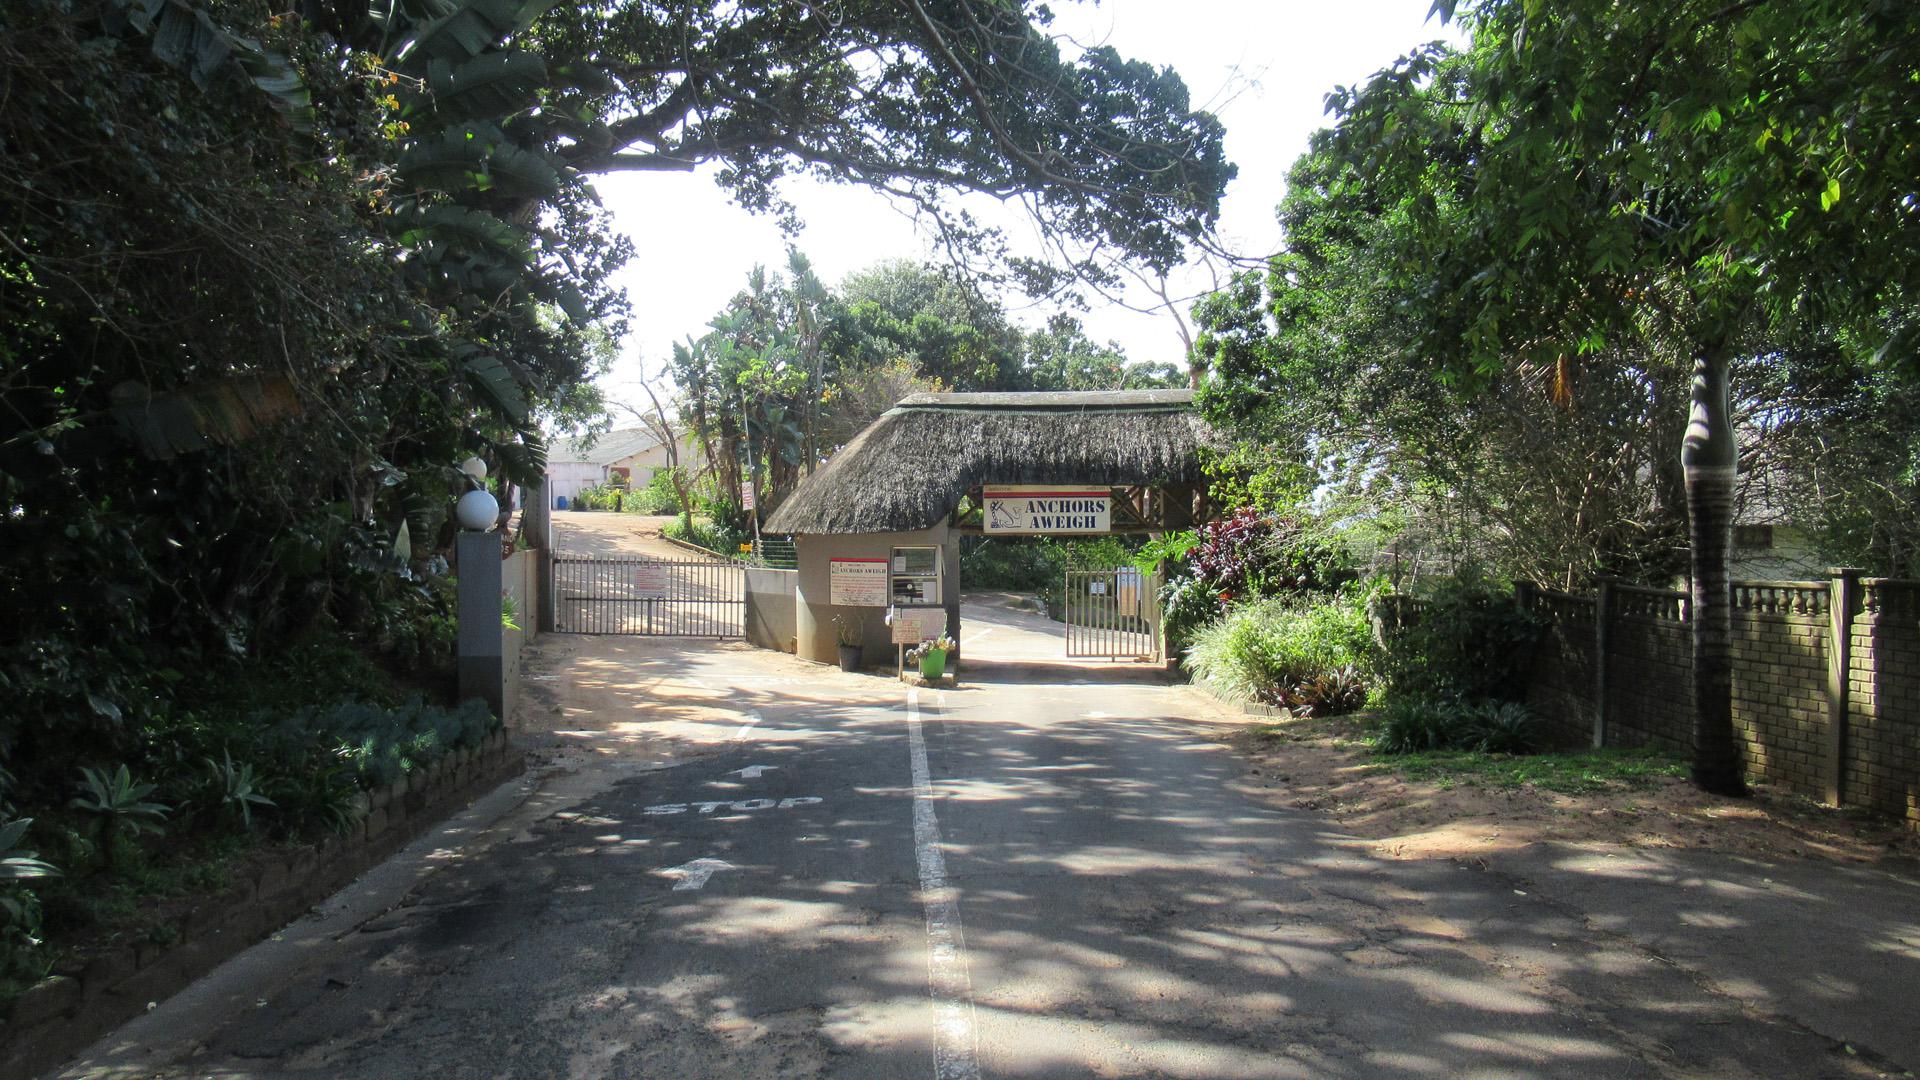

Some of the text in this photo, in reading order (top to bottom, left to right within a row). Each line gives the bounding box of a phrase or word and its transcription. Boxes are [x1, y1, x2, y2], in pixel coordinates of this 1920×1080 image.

[743, 485, 753, 507] STOP
[1025, 500, 1105, 514] ANCHORS
[1029, 516, 1097, 529] AWEIGH
[643, 796, 824, 815] STOP
